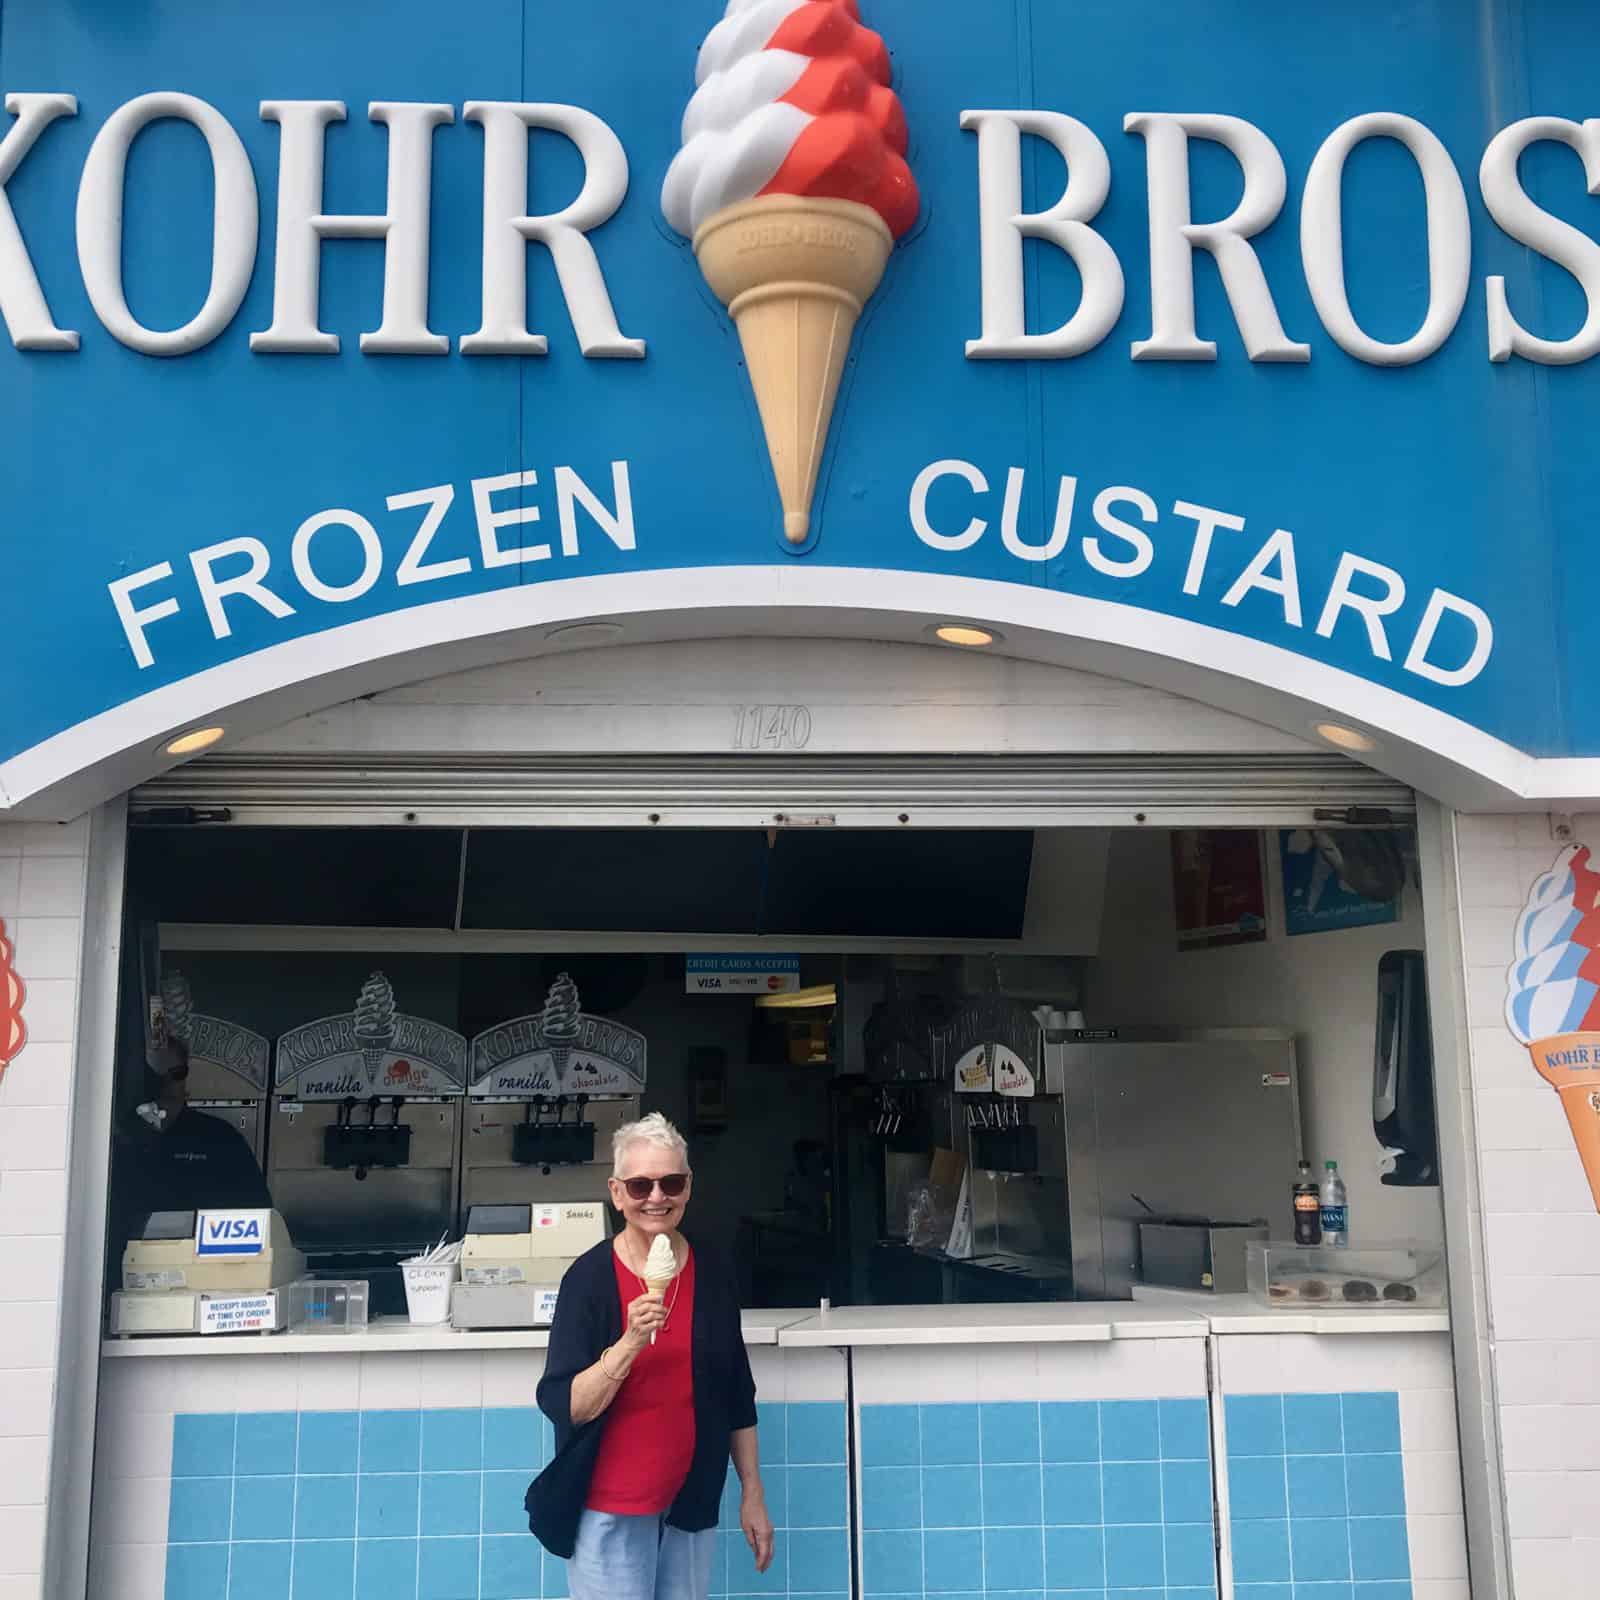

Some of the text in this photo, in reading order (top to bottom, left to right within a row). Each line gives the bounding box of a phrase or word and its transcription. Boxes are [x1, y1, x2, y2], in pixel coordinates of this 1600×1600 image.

[959, 109, 1600, 367] BROS
[107, 458, 1494, 687] FROZEN CUSTARD
[733, 704, 811, 750] 1140
[721, 959, 752, 969] CARDS
[755, 959, 800, 969] ACCEPTED
[697, 975, 722, 989] VISA
[281, 1020, 461, 1067] KOHR BROS
[480, 1020, 641, 1065] KOHR BROS
[1545, 1048, 1590, 1068] KOHR
[305, 1072, 363, 1095] vanilla
[499, 1072, 552, 1090] vanilla
[572, 1072, 619, 1089] chocolate
[210, 1220, 259, 1239] VISA
[207, 1309, 271, 1320] AT TIME OF ORDER
[210, 1300, 268, 1311] RECEIPT ISSUED
[217, 1319, 261, 1329] OR IT'S FREE
